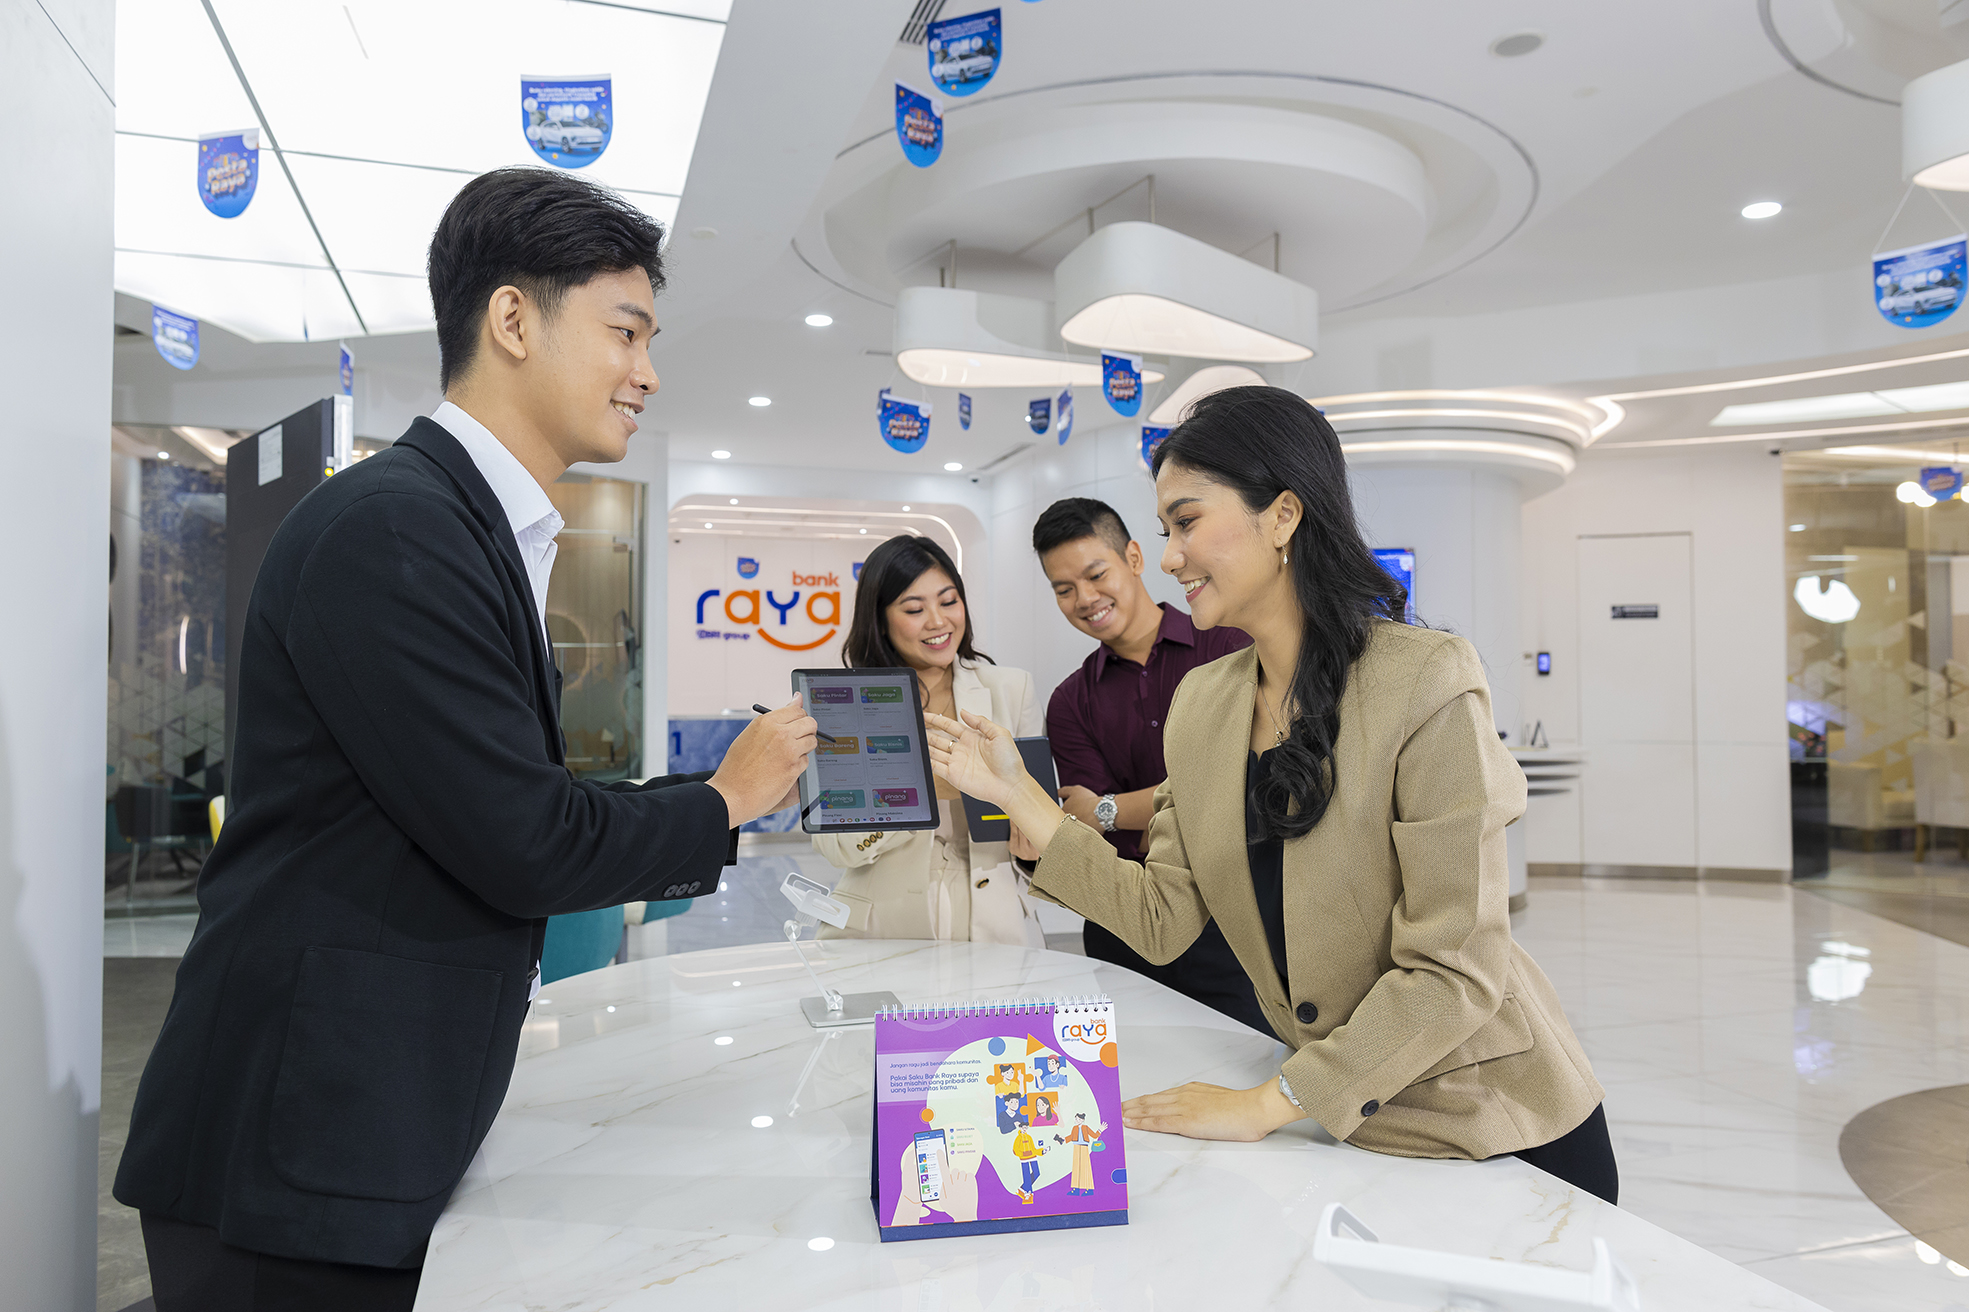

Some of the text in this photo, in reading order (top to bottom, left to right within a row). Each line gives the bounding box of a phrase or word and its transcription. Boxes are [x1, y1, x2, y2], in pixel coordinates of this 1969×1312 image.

[207, 159, 248, 183] Pesta
[211, 173, 246, 195] Raya
[792, 571, 839, 587] bank
[696, 589, 840, 626] raya
[723, 632, 750, 641] group
[671, 731, 682, 755] 1
[831, 794, 854, 803] pinang
[1061, 1023, 1107, 1038] raya
